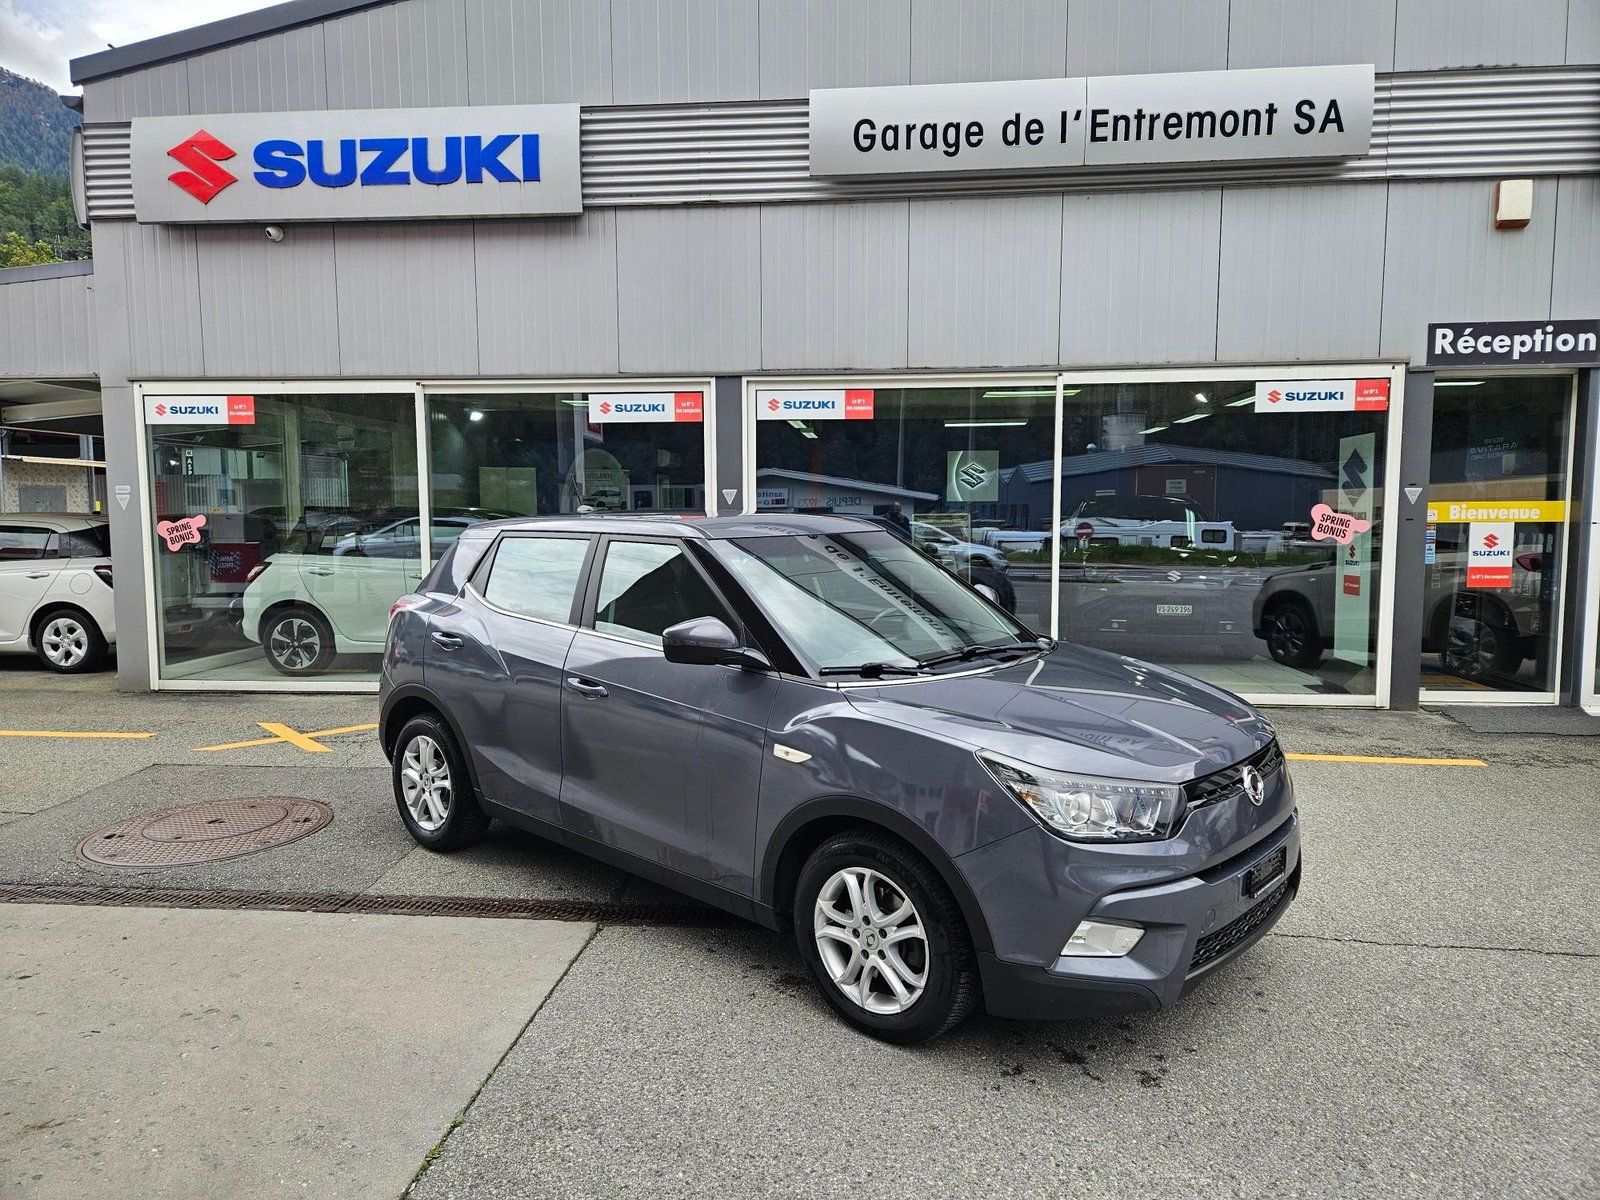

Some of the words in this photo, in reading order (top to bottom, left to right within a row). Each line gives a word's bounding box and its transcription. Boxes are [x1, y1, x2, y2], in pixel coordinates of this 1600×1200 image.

[853, 118, 984, 157] Garage
[1002, 112, 1044, 146] de
[1060, 102, 1278, 143] l'Entremont
[1293, 99, 1345, 135] SA
[253, 134, 541, 188] SUZUKI
[1434, 325, 1597, 360] Réception
[1285, 391, 1344, 401] SUZUKI
[170, 405, 219, 415] SUZUKI
[614, 403, 665, 413] SUZUKI
[783, 400, 835, 410] SUZUKI
[1449, 504, 1541, 520] Bienvenue
[166, 521, 192, 536] SPRING
[1320, 513, 1351, 529] SPRING
[169, 530, 195, 545] BONUS
[1317, 523, 1348, 539] BONUS
